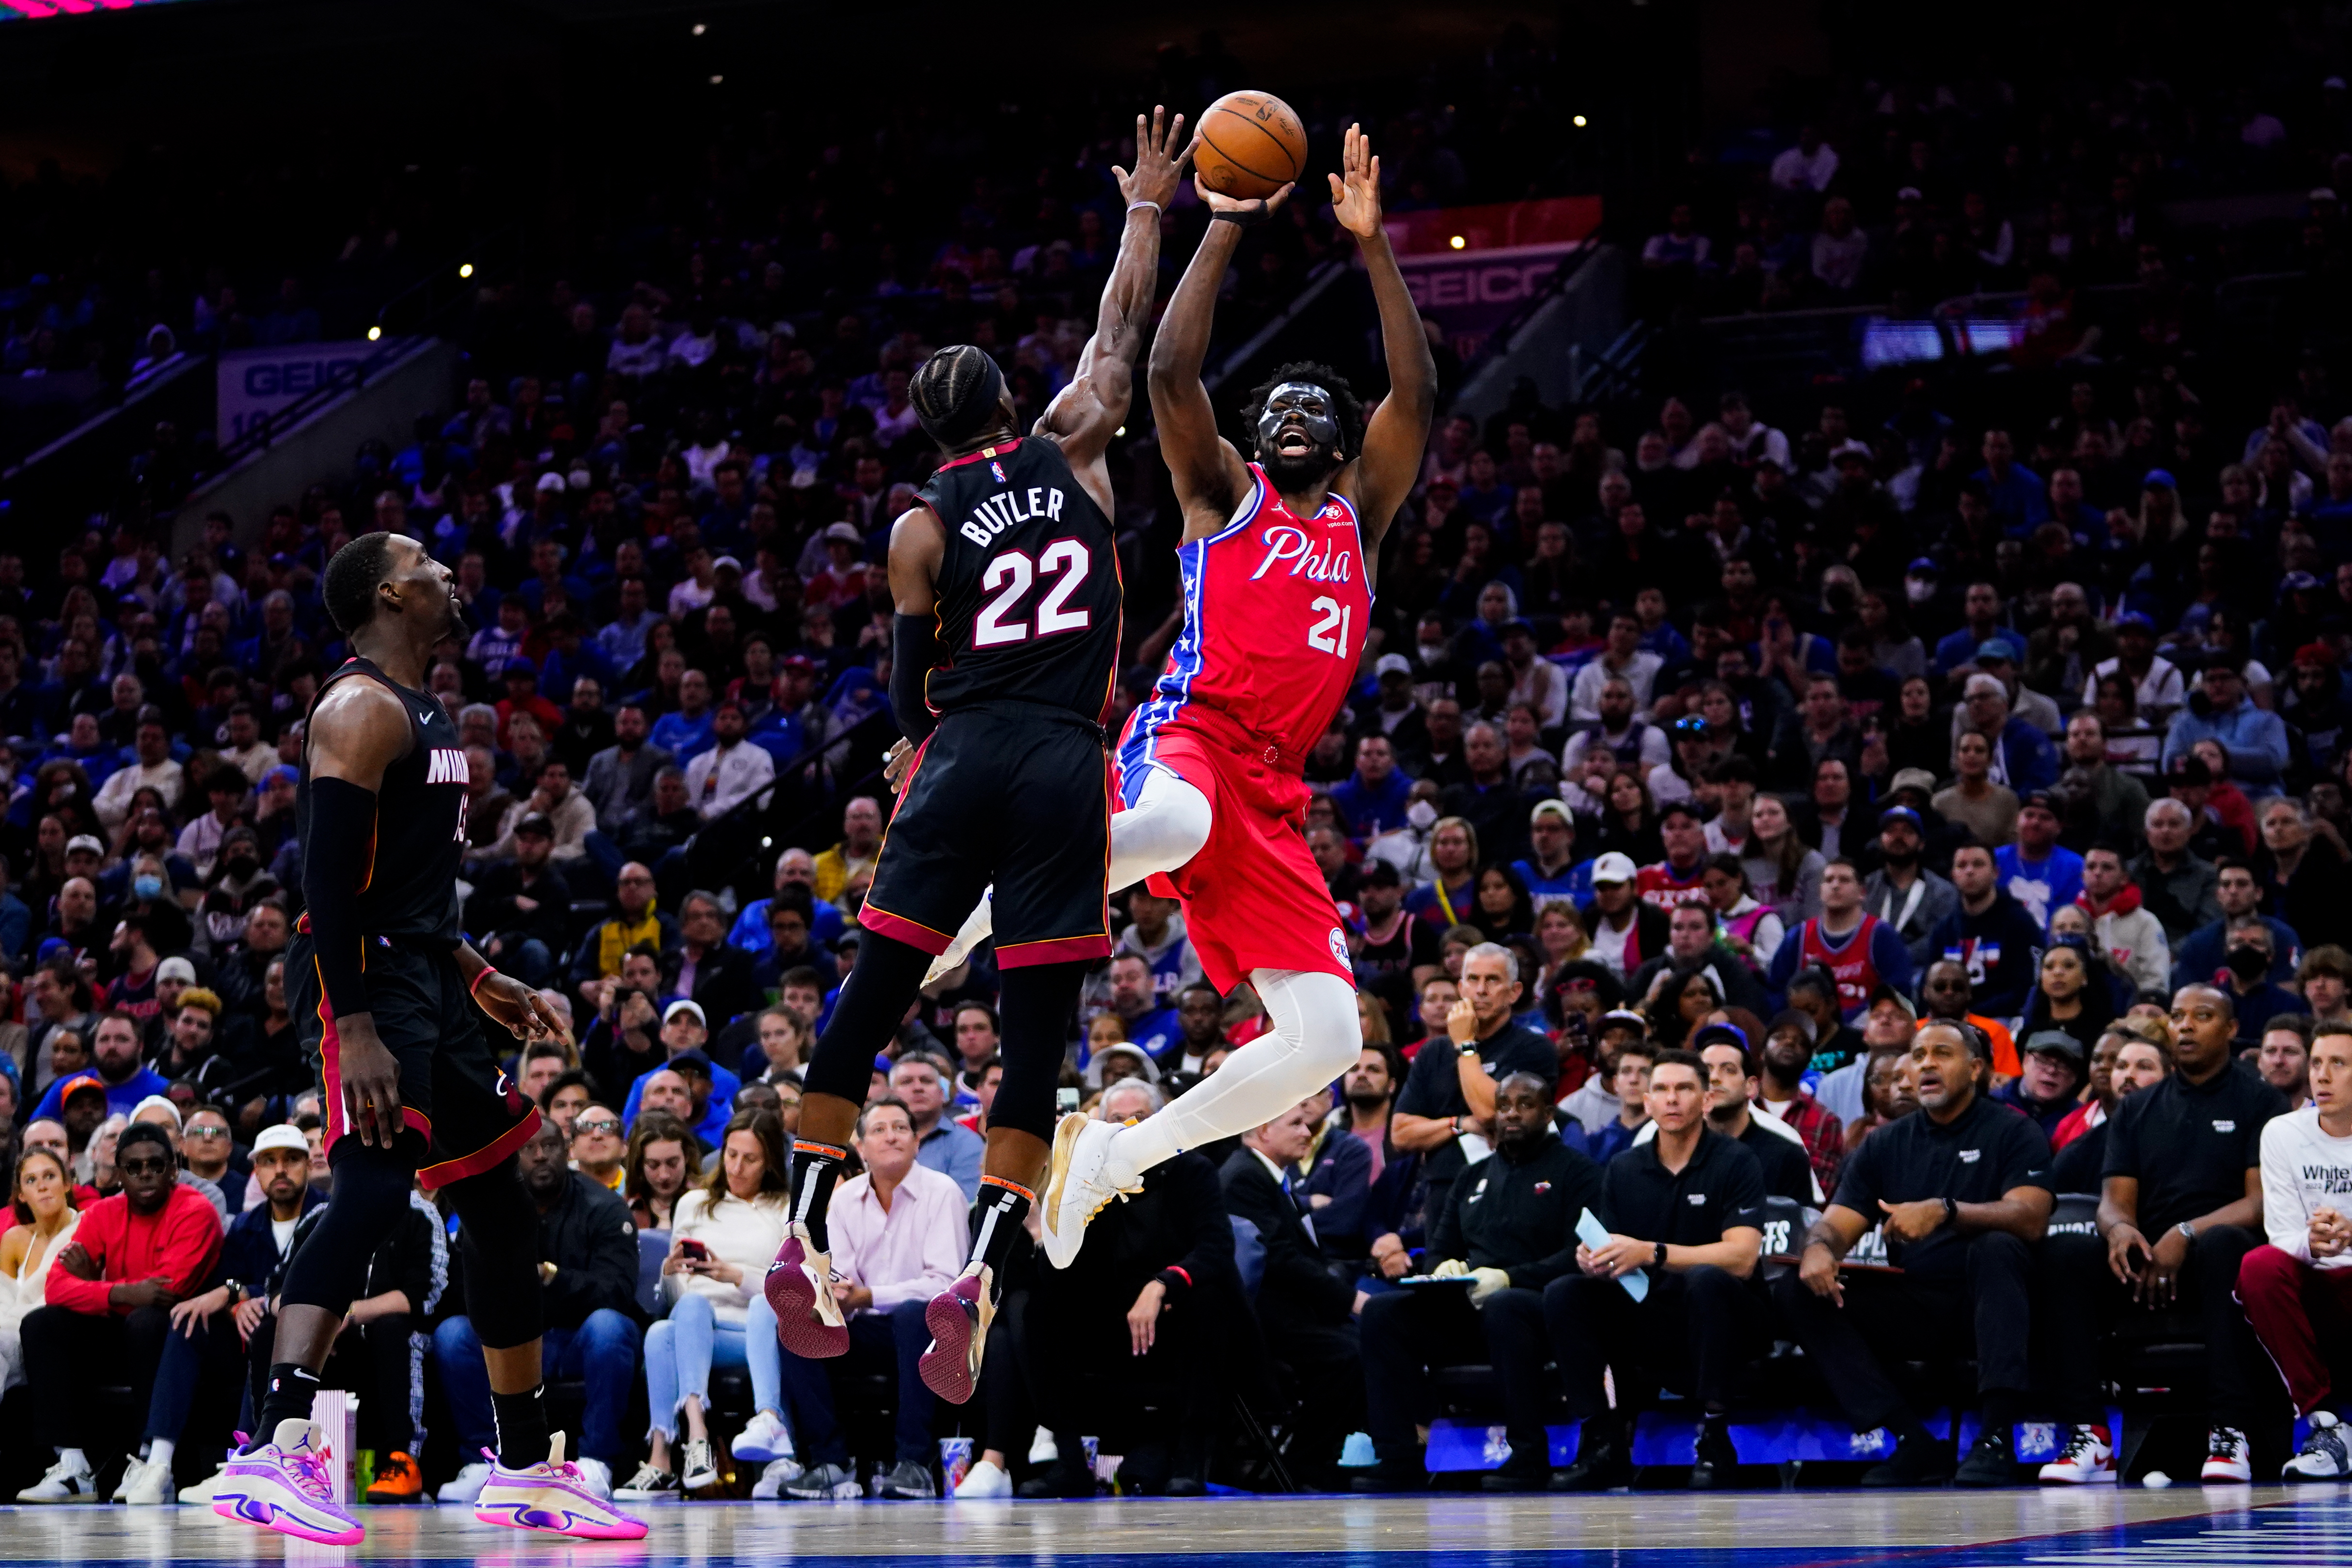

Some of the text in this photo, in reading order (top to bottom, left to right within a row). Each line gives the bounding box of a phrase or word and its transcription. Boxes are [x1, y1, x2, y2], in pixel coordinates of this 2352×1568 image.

[960, 486, 1064, 548] BUTLER
[1249, 525, 1351, 583] Phila
[972, 535, 1091, 645] 22
[1308, 595, 1351, 659] 21
[2303, 1164, 2350, 1180] White
